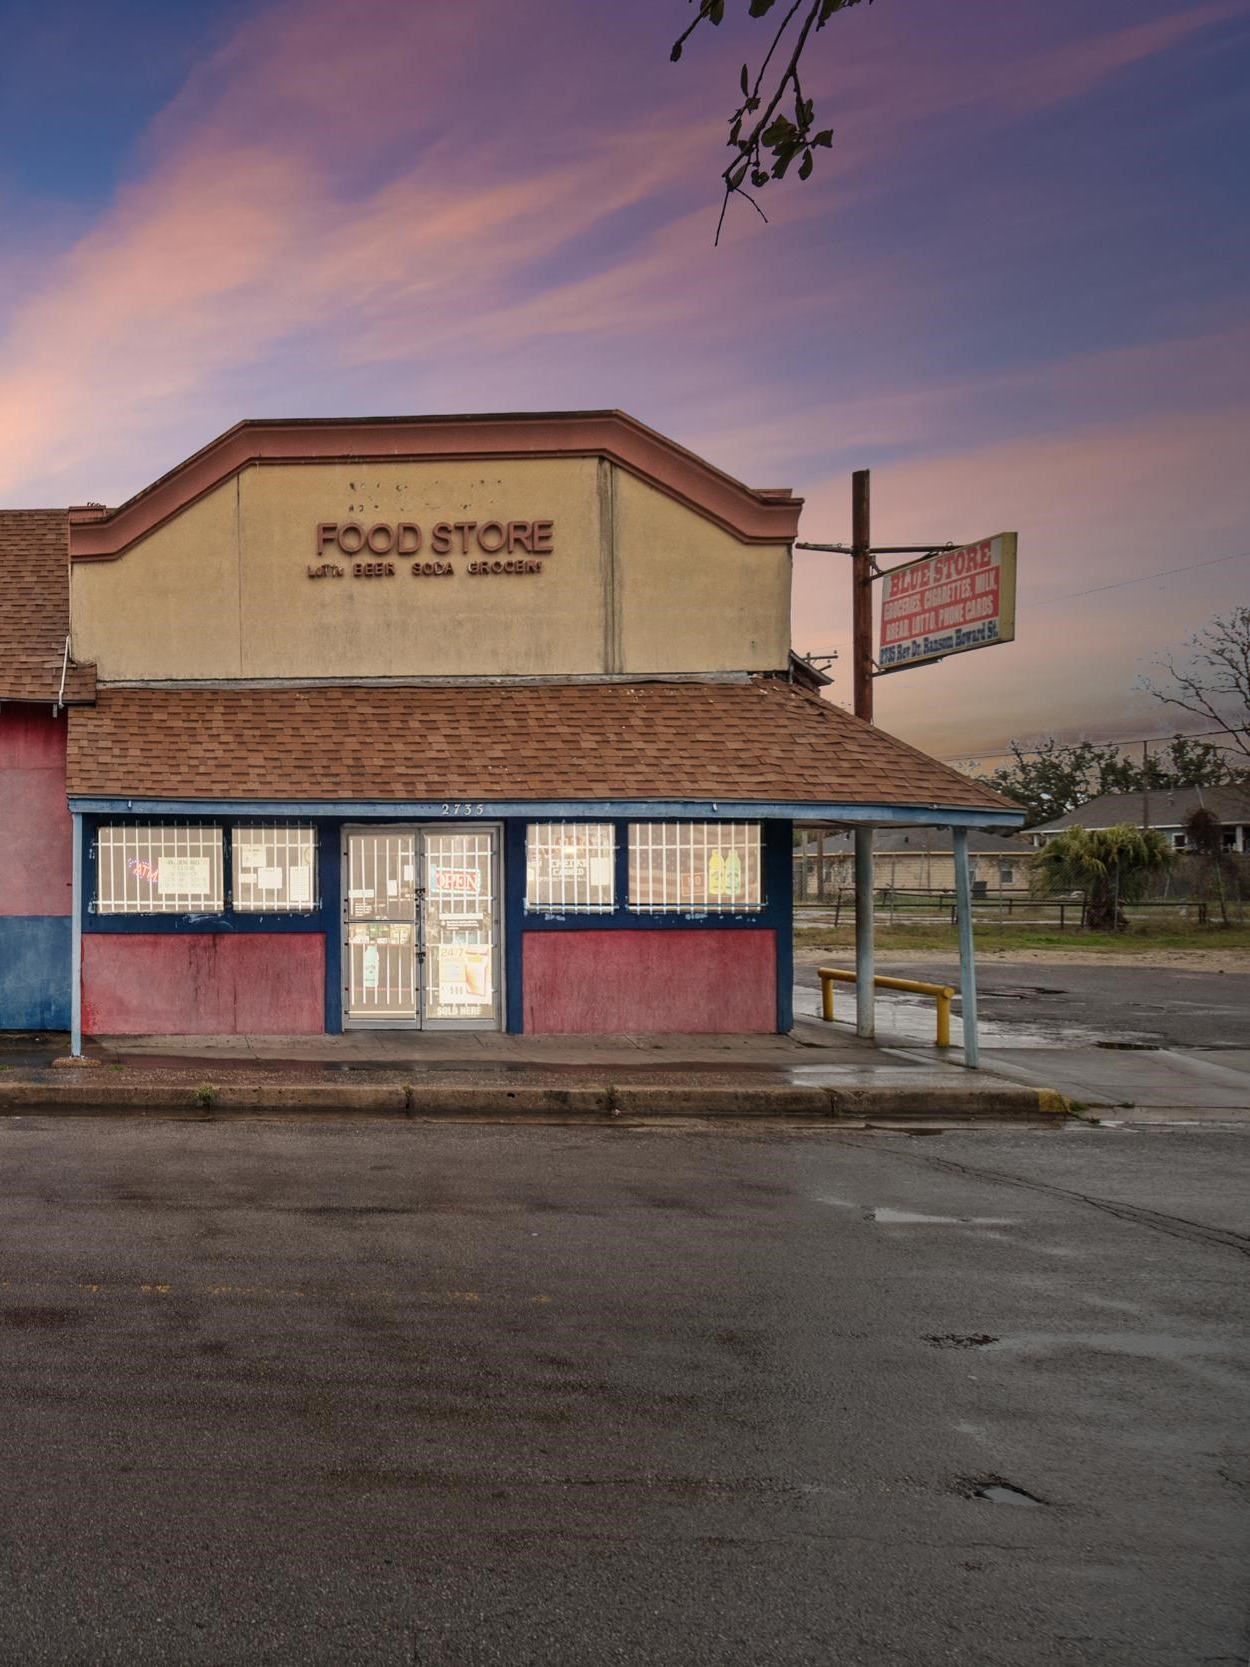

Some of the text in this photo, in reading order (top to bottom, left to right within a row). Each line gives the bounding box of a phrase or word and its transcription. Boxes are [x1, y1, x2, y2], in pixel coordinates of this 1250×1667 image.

[317, 520, 554, 556] FOOD STORE
[353, 561, 396, 577] BEER
[411, 561, 455, 577] SODA
[890, 541, 991, 597] BLUE STORE
[939, 603, 964, 628] PHONE
[965, 595, 994, 621] CARDS
[955, 624, 986, 647] Howard
[441, 804, 484, 816] 2735
[133, 863, 159, 882] ATM
[437, 873, 479, 890] OPEN
